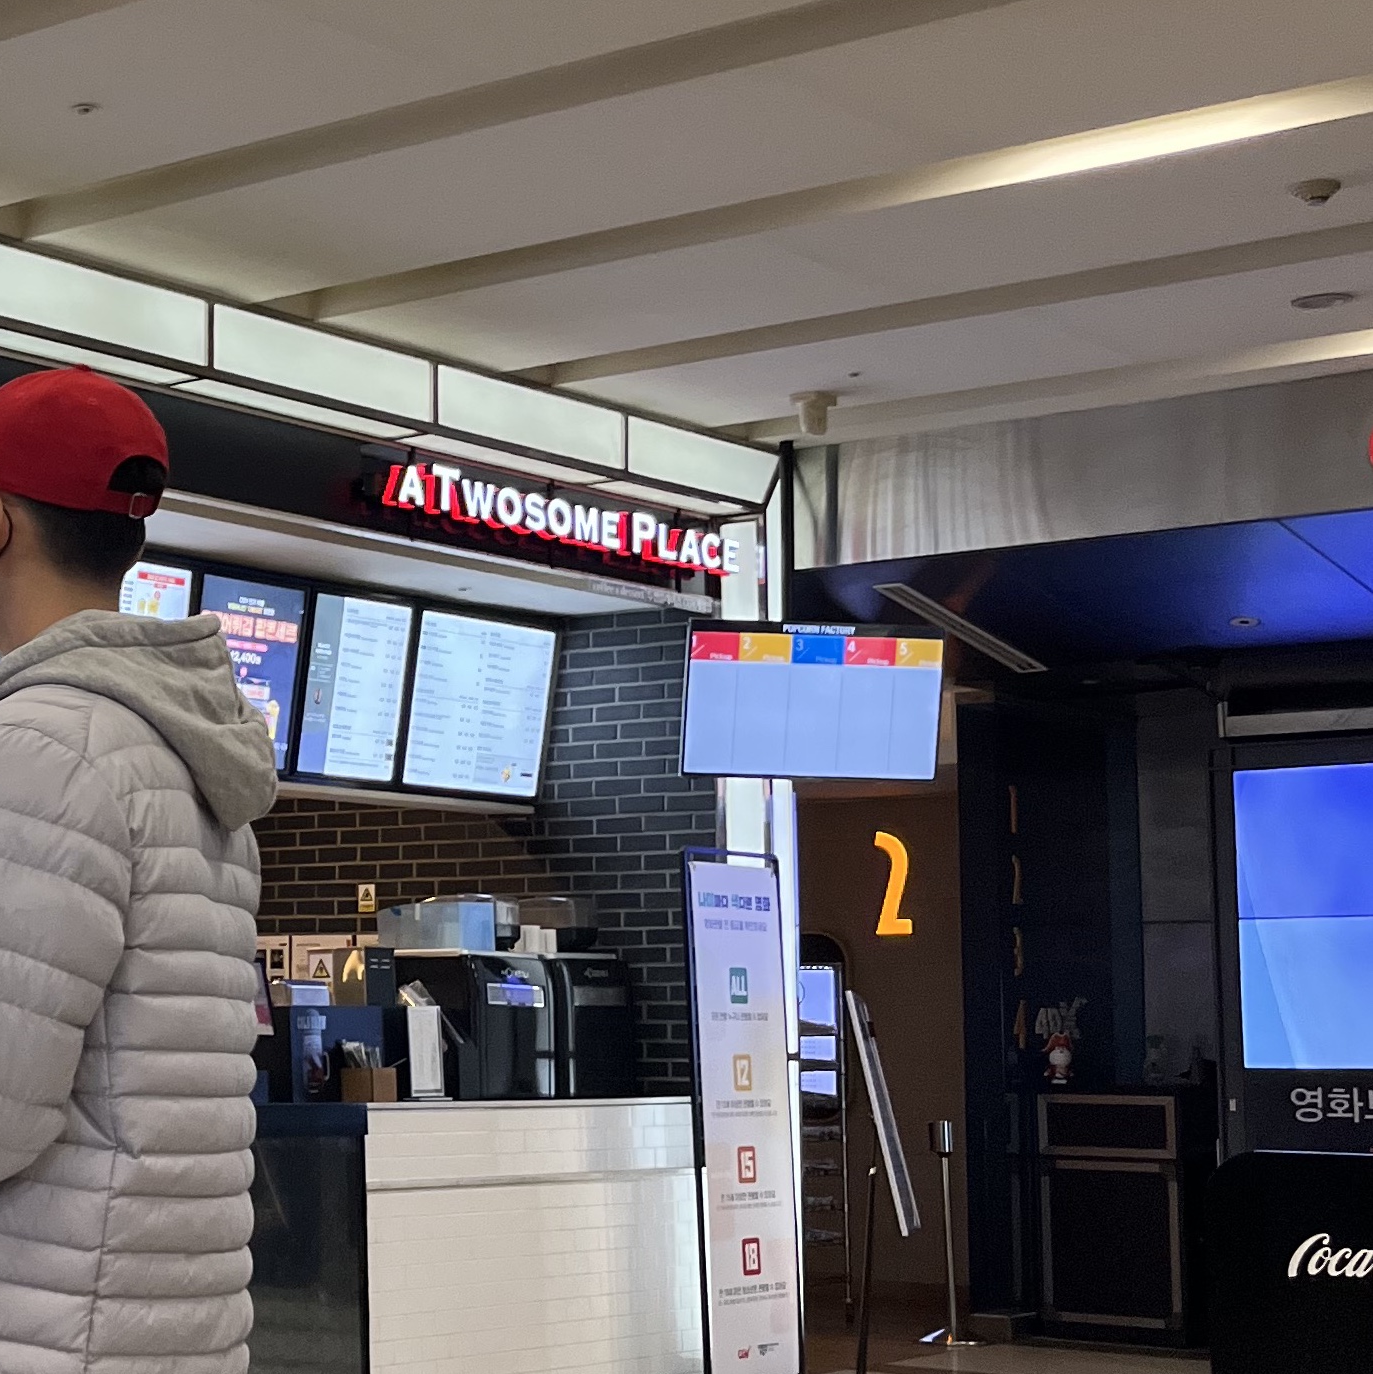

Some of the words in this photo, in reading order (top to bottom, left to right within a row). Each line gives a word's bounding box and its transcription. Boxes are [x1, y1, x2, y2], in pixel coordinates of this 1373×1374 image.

[399, 464, 425, 506] A
[433, 462, 621, 551] TWOSOME
[631, 511, 740, 573] PLACE
[821, 624, 856, 635] FACTORY
[743, 637, 751, 649] 2
[796, 639, 804, 651] 3
[846, 641, 856, 652] 4
[900, 643, 908, 655] 5
[874, 831, 913, 935] 2
[731, 974, 747, 997] ALL
[736, 1058, 750, 1086] 12
